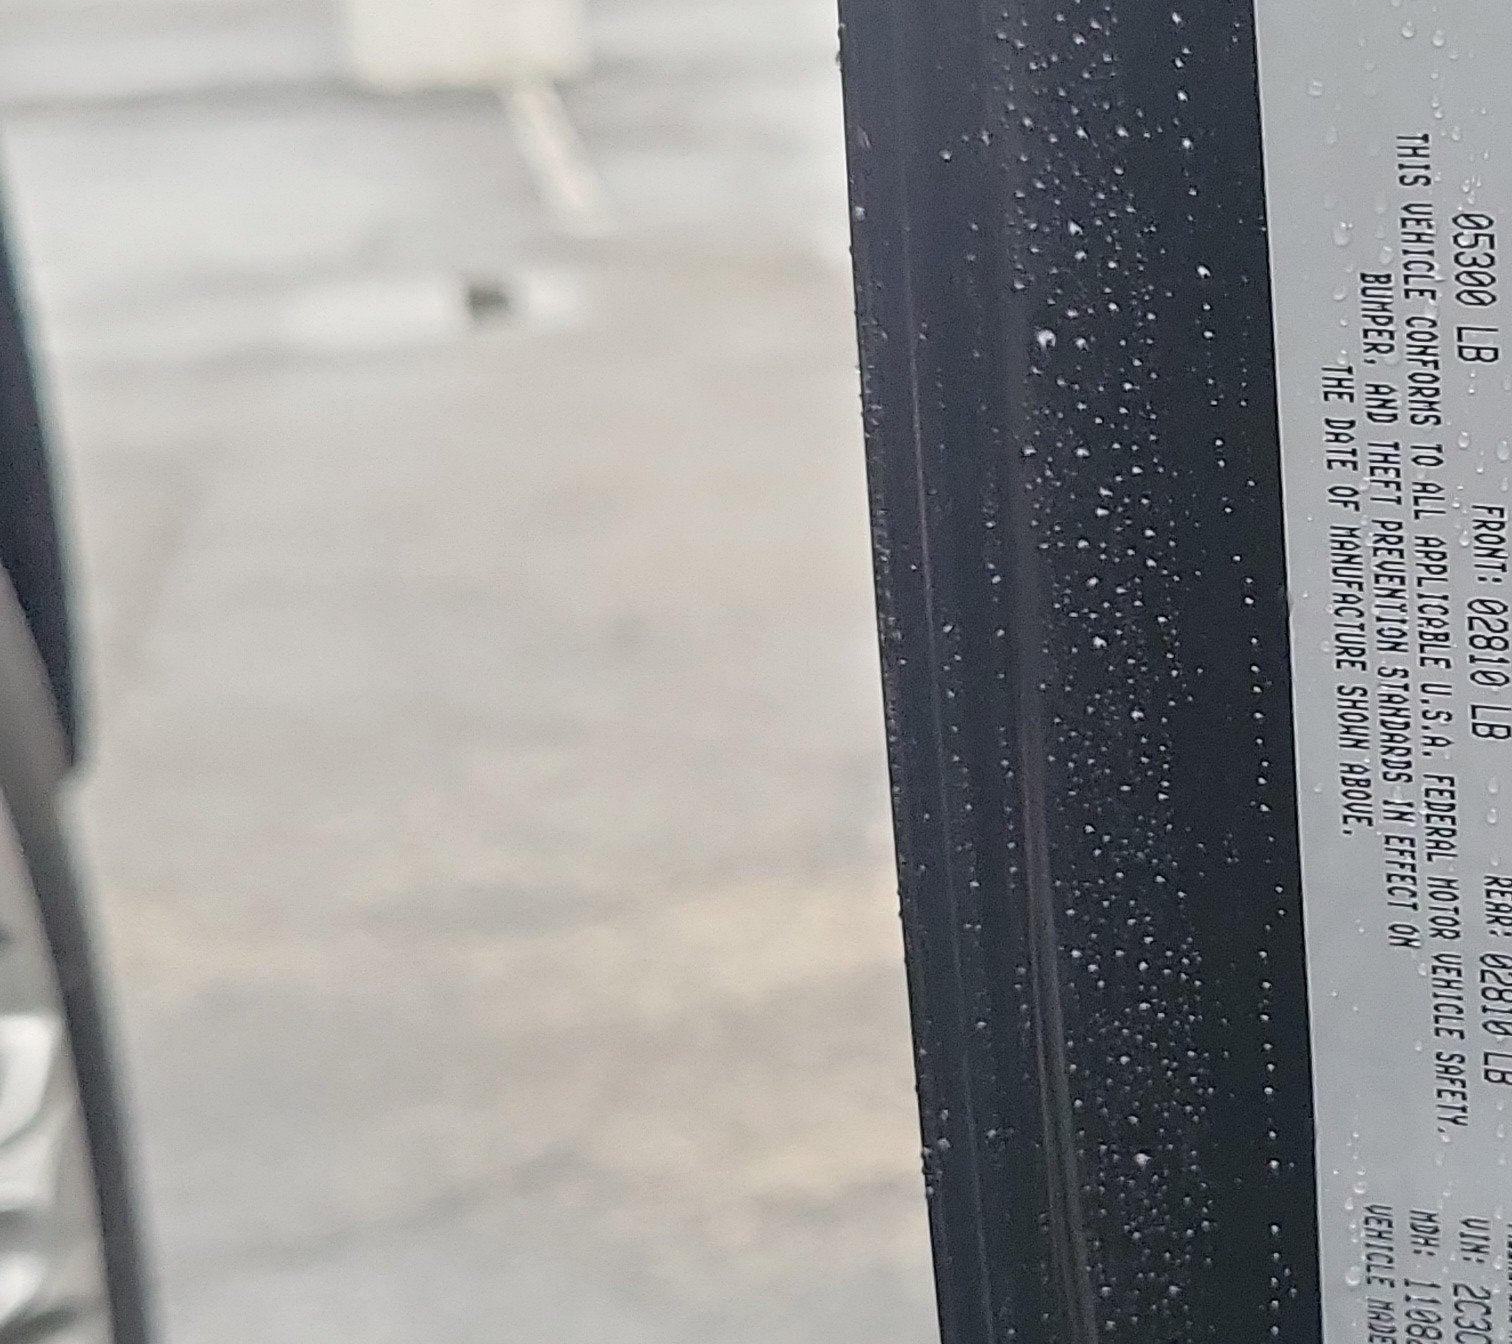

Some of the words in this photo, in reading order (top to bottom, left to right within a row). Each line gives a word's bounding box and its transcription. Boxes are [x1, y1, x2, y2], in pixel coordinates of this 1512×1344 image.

[1397, 134, 1431, 186] THIS
[1400, 204, 1436, 300] VEHICLE
[1452, 213, 1496, 306] 05300
[1360, 273, 1395, 364] BUMPER,
[1457, 327, 1498, 362] LB
[1322, 366, 1354, 403] THE
[1365, 384, 1398, 423] AND
[1405, 317, 1441, 425] CONFORMS
[1325, 418, 1358, 471] DATE
[1368, 442, 1402, 505] THEFT
[1411, 444, 1443, 466] TO
[1328, 486, 1360, 511] OF
[1412, 482, 1446, 520] ALL
[1472, 505, 1508, 582] FRONT:
[1330, 526, 1366, 671] MANUFACTURE
[1372, 520, 1408, 652] PREVENTION
[1415, 536, 1451, 669] APPLICABLE
[1467, 599, 1510, 686] 02810
[1337, 686, 1369, 749] SHOWN
[1378, 667, 1413, 783] STANDARDS
[1420, 684, 1453, 756] U.S.A.
[1471, 705, 1511, 739] LB
[1340, 763, 1373, 834] ABOVE.
[1383, 800, 1415, 822] IN
[1423, 775, 1457, 861] FEDERAL
[1385, 835, 1418, 911] EFFECT
[1427, 877, 1460, 939] MOTOR
[1388, 924, 1420, 949] ON
[1432, 954, 1465, 1040] VEHICLE
[1436, 1052, 1468, 1132] SAFETY.
[1364, 1205, 1395, 1288] VEHICLE
[1410, 1210, 1440, 1256] MDH:
[1459, 1219, 1490, 1264] VIN:
